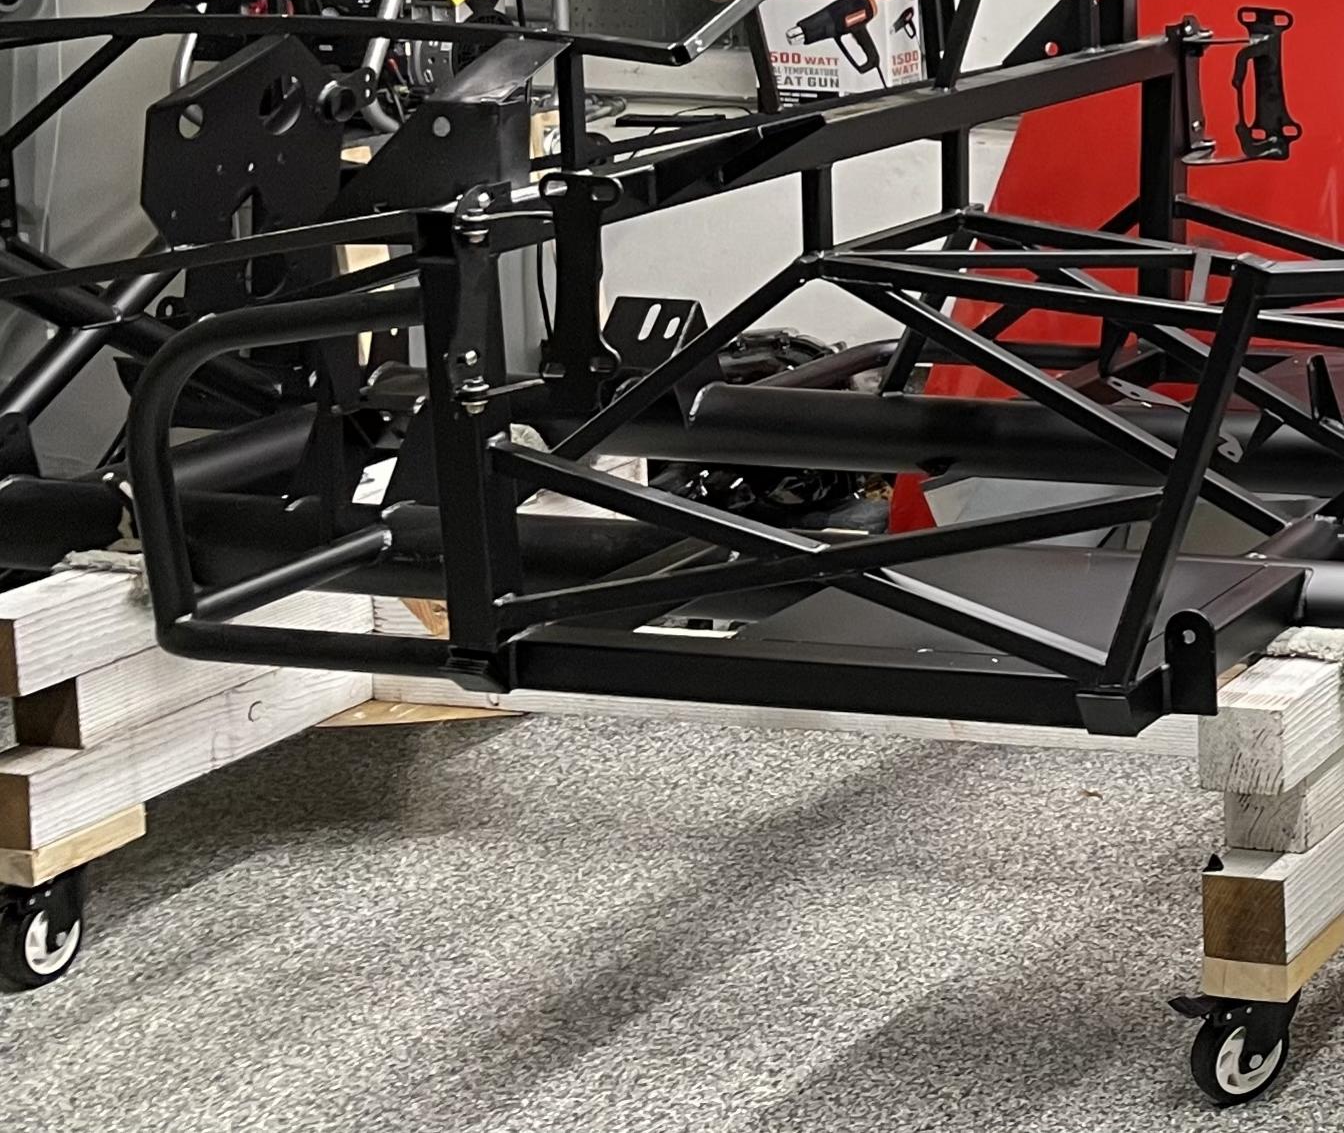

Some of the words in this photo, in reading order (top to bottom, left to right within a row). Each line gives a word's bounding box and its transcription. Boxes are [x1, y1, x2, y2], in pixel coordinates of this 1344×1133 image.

[769, 52, 801, 64] 500
[805, 57, 839, 66] WATT
[892, 51, 919, 65] 1500
[892, 65, 919, 77] WATT
[775, 75, 803, 86] EAT
[808, 77, 840, 88] GUN
